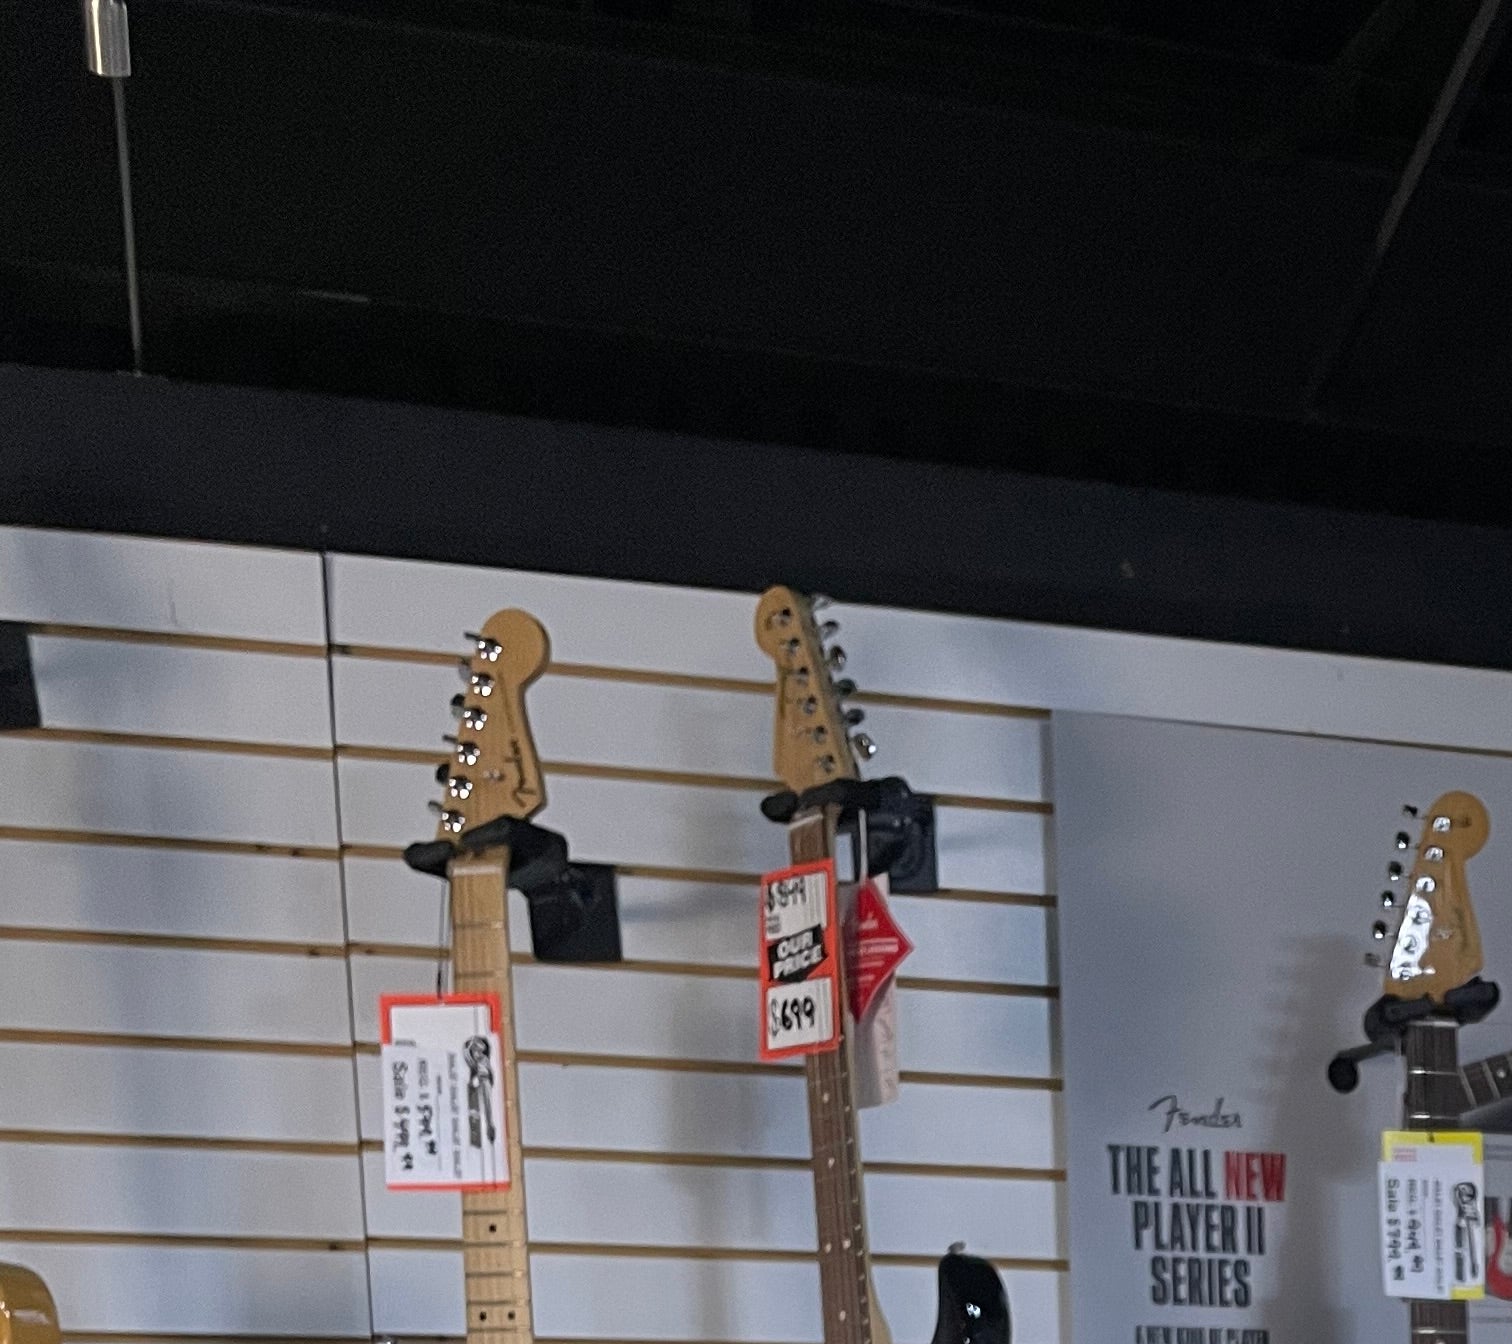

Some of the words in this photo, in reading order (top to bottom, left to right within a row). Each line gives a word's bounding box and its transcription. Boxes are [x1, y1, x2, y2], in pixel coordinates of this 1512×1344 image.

[773, 944, 823, 980] PRICE
[777, 930, 815, 960] OUR
[769, 996, 816, 1037] $699
[1148, 1094, 1242, 1133] Fender
[1107, 1144, 1161, 1196] THE
[1169, 1147, 1217, 1198] ALL
[1224, 1150, 1287, 1202] NEW
[1133, 1200, 1238, 1254] PLAYER
[1246, 1205, 1266, 1256] II
[1151, 1255, 1251, 1308] SERIES
